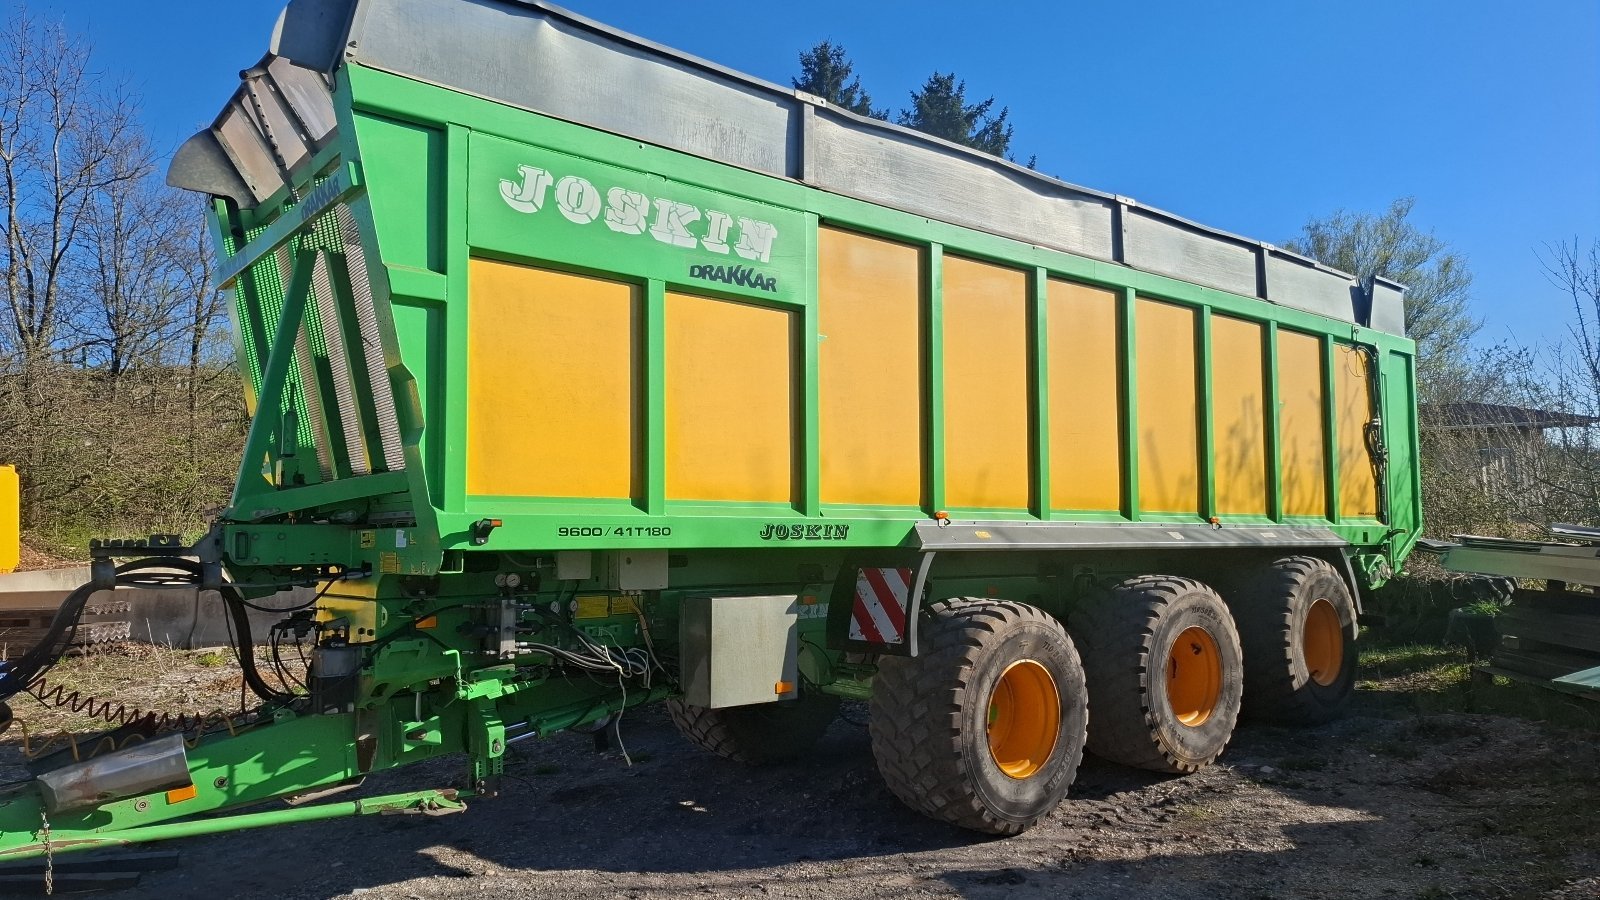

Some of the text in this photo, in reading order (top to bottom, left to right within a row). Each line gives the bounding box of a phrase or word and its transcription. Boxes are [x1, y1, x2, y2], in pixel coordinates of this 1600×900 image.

[498, 163, 778, 263] JOSKIN
[689, 264, 777, 293] DRAKKAR
[759, 524, 850, 540] JOSKIN
